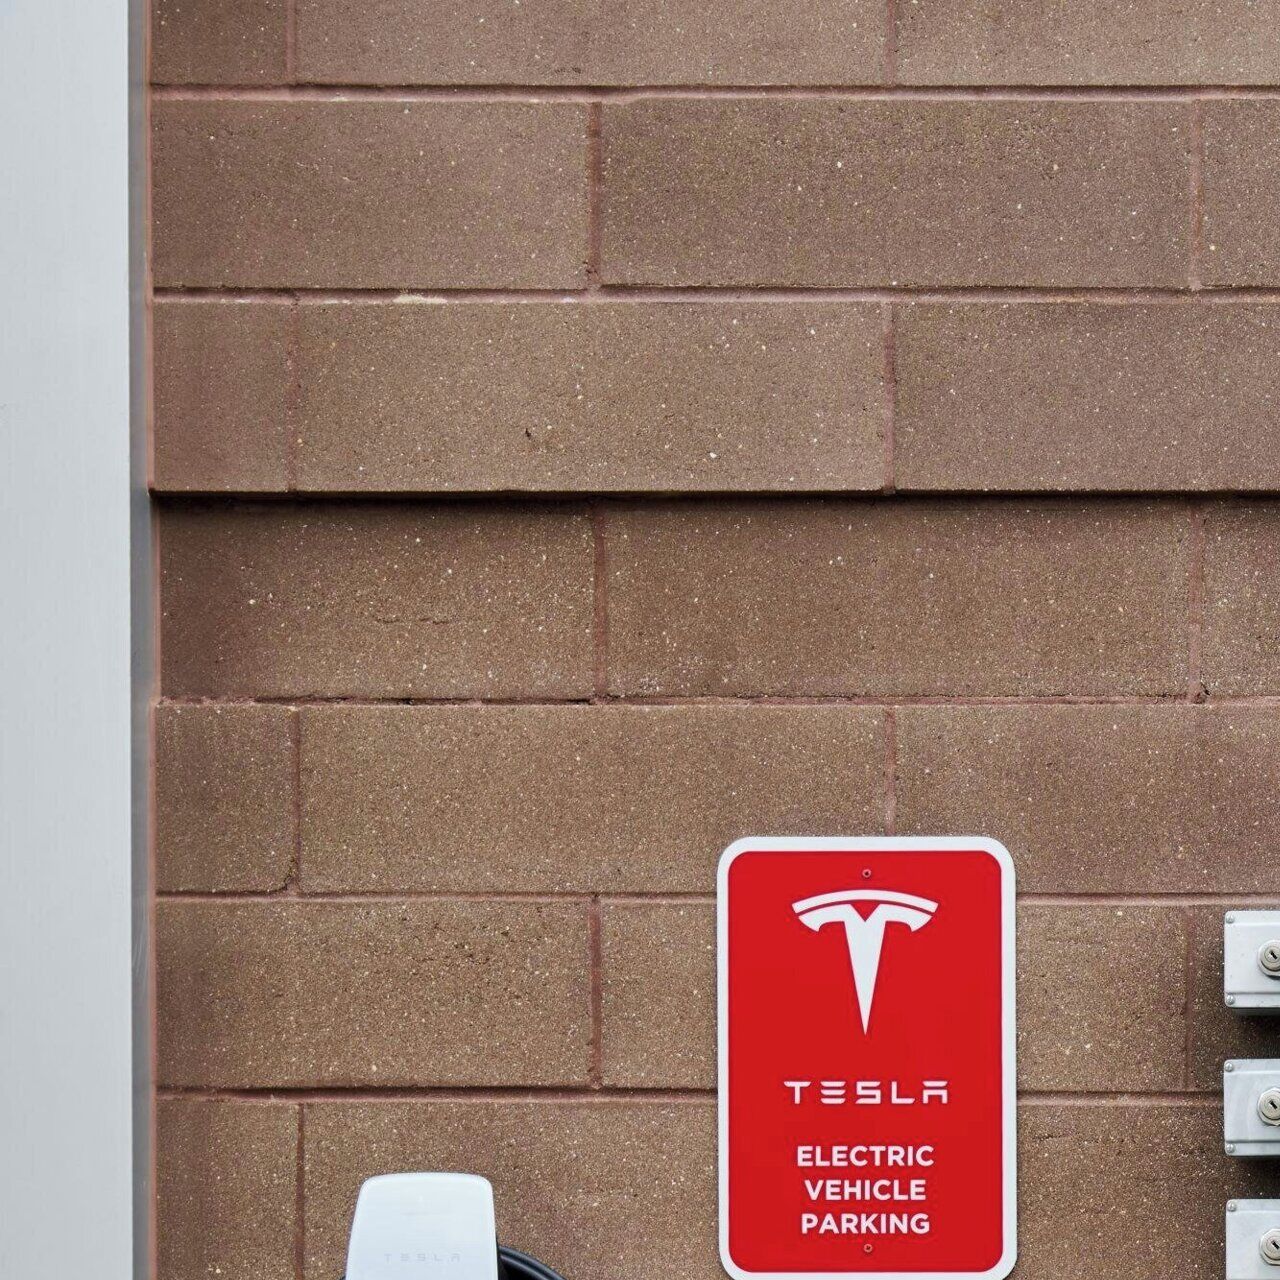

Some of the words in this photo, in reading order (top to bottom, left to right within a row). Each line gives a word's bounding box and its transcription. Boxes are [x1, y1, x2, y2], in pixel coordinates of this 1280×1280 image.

[784, 1081, 948, 1105] TESLA
[797, 1145, 934, 1167] ELECTRIC
[804, 1179, 927, 1201] VEHICLE
[801, 1212, 930, 1235] PARKING
[384, 1251, 460, 1264] TESLA
